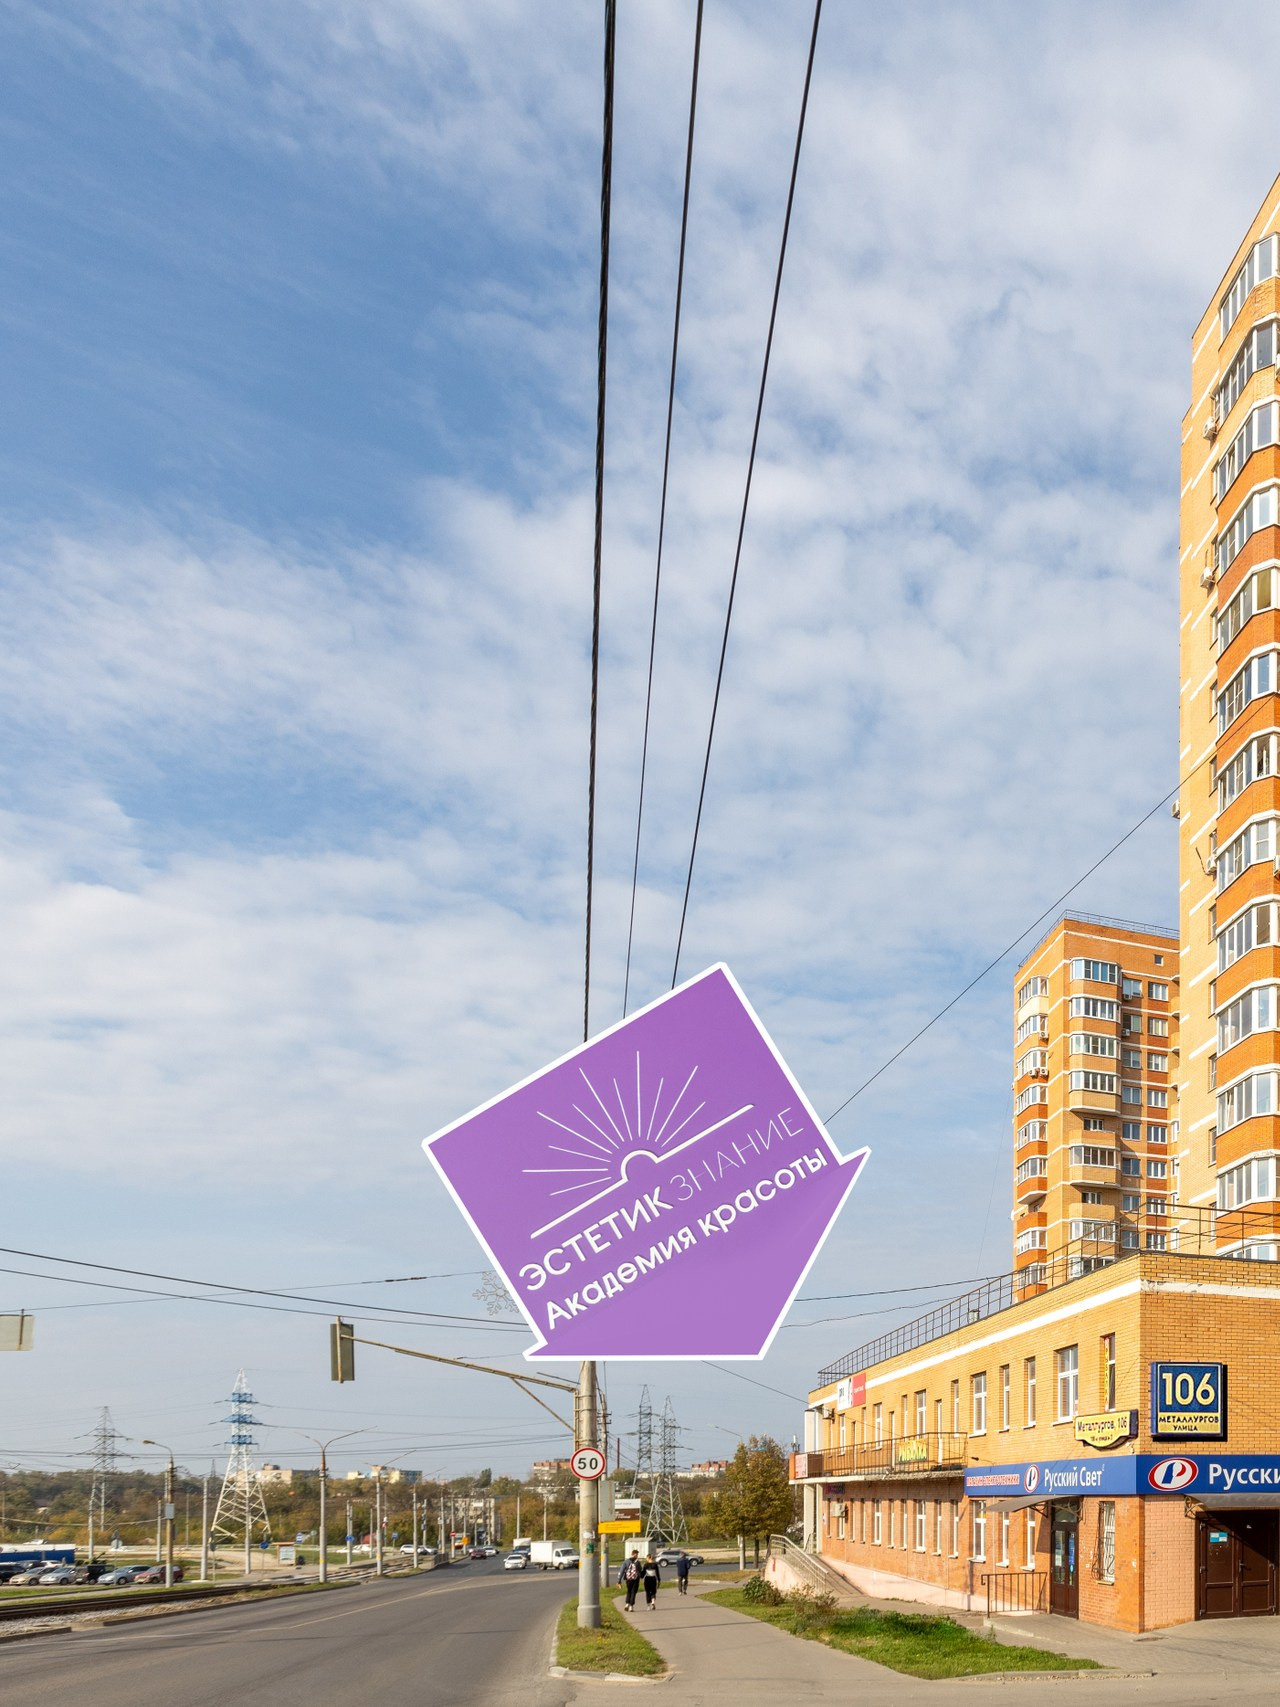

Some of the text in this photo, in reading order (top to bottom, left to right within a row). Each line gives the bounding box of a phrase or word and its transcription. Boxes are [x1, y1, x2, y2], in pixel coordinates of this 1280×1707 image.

[519, 1107, 804, 1291] ЭСТЕТИК ЗНАНИЕ
[546, 1148, 828, 1330] Академия красоты
[1162, 1372, 1215, 1406] 106
[1158, 1415, 1219, 1423] МЕТАЛЛУРГОВ
[578, 1457, 598, 1470] 50
[1044, 1466, 1078, 1492] Русский
